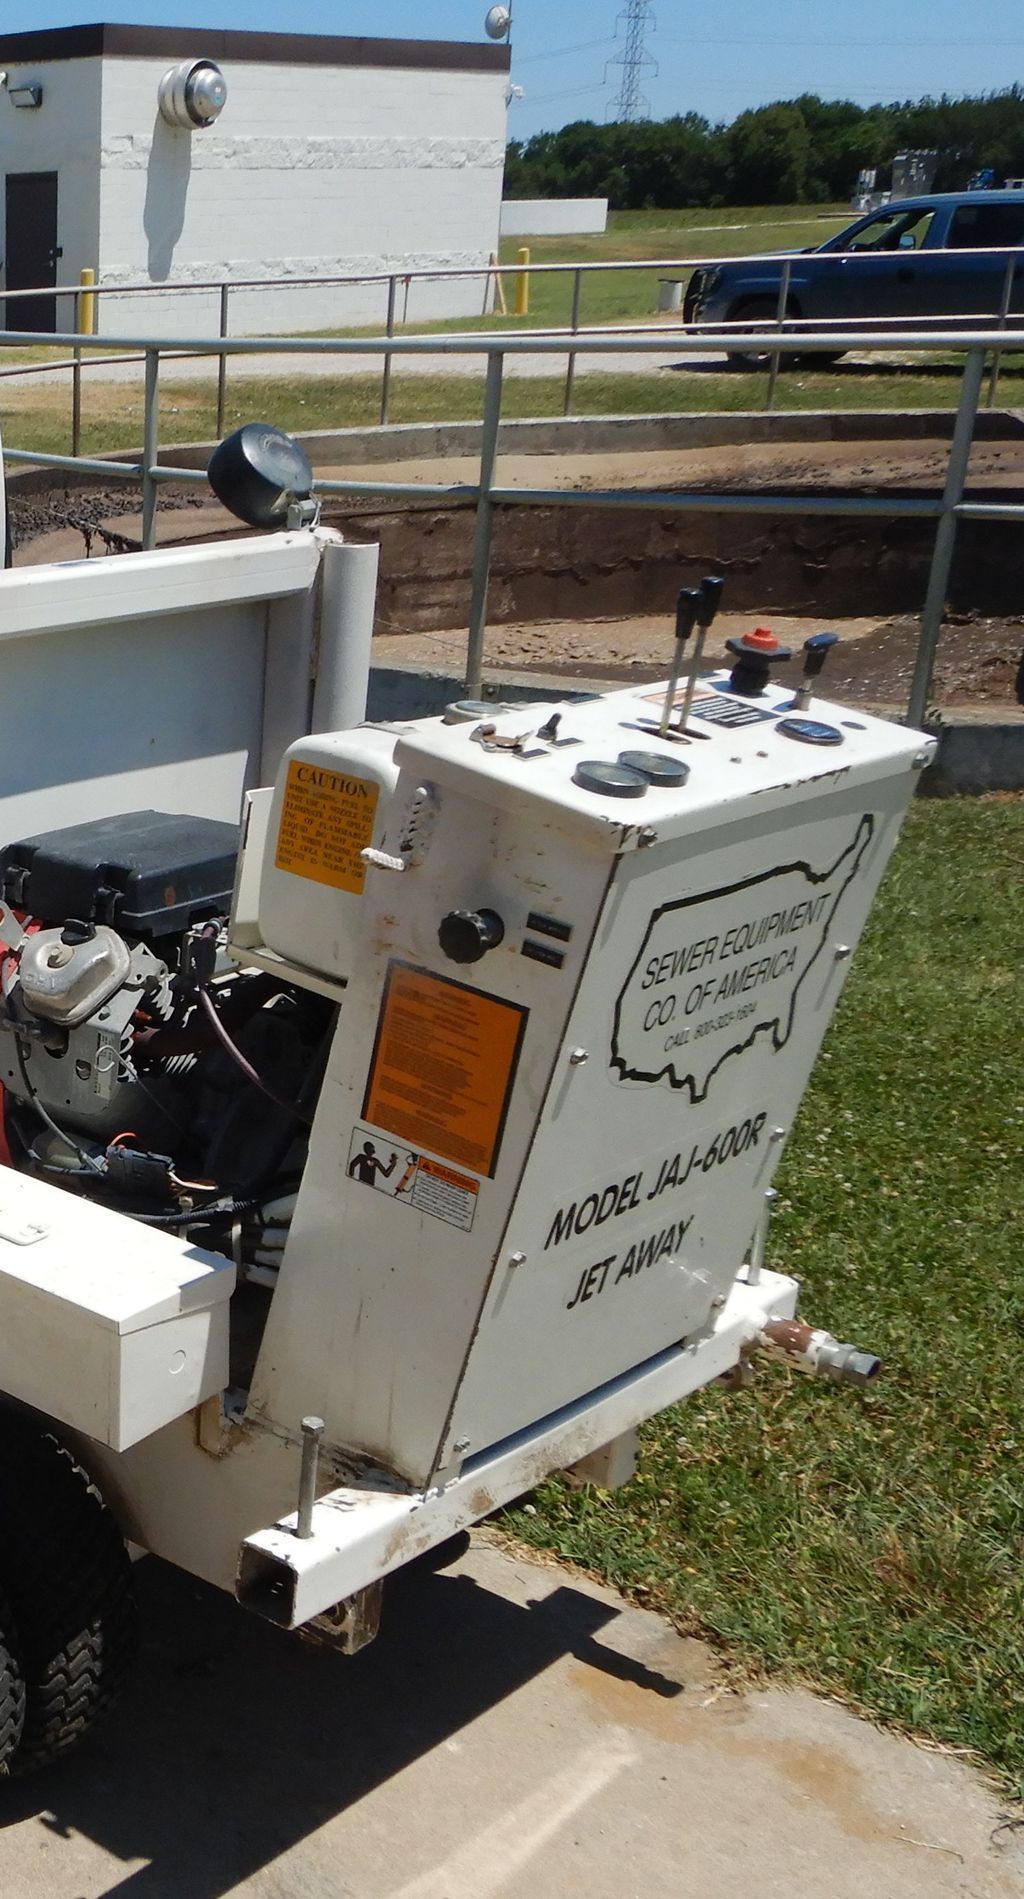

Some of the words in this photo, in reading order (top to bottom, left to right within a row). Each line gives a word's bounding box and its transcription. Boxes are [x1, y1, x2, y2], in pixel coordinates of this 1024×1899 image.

[297, 767, 368, 798] CAUTION
[641, 936, 719, 990] SEWER
[719, 893, 831, 960] EQUIPMENT
[643, 995, 676, 1032] CO.
[685, 979, 717, 1015] OF
[714, 946, 797, 1004] AMERICA
[664, 1028, 691, 1052] CALL
[544, 1172, 643, 1250] MODEL
[647, 1112, 767, 1200] JAJ-600R
[566, 1255, 617, 1309] JET
[615, 1215, 695, 1285] AWAY
